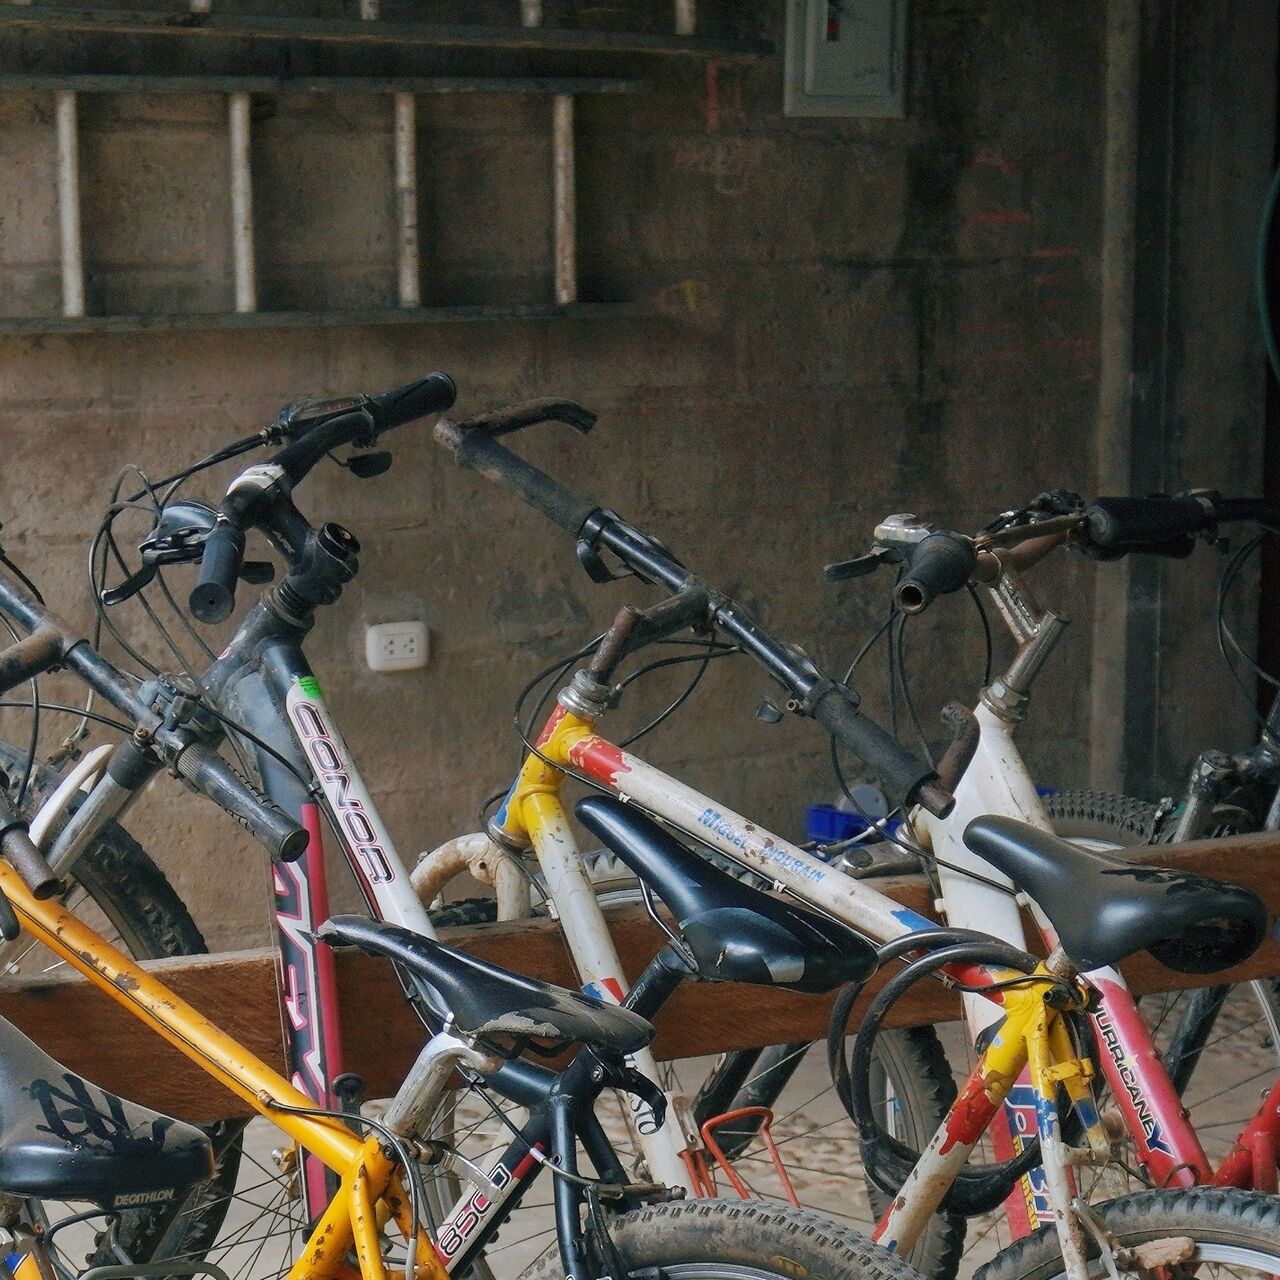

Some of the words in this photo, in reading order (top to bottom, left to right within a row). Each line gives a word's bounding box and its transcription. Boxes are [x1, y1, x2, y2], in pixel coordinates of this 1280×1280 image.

[293, 702, 395, 885] CONOR
[114, 1187, 174, 1206] DECATHLON
[437, 1161, 512, 1260] 8500
